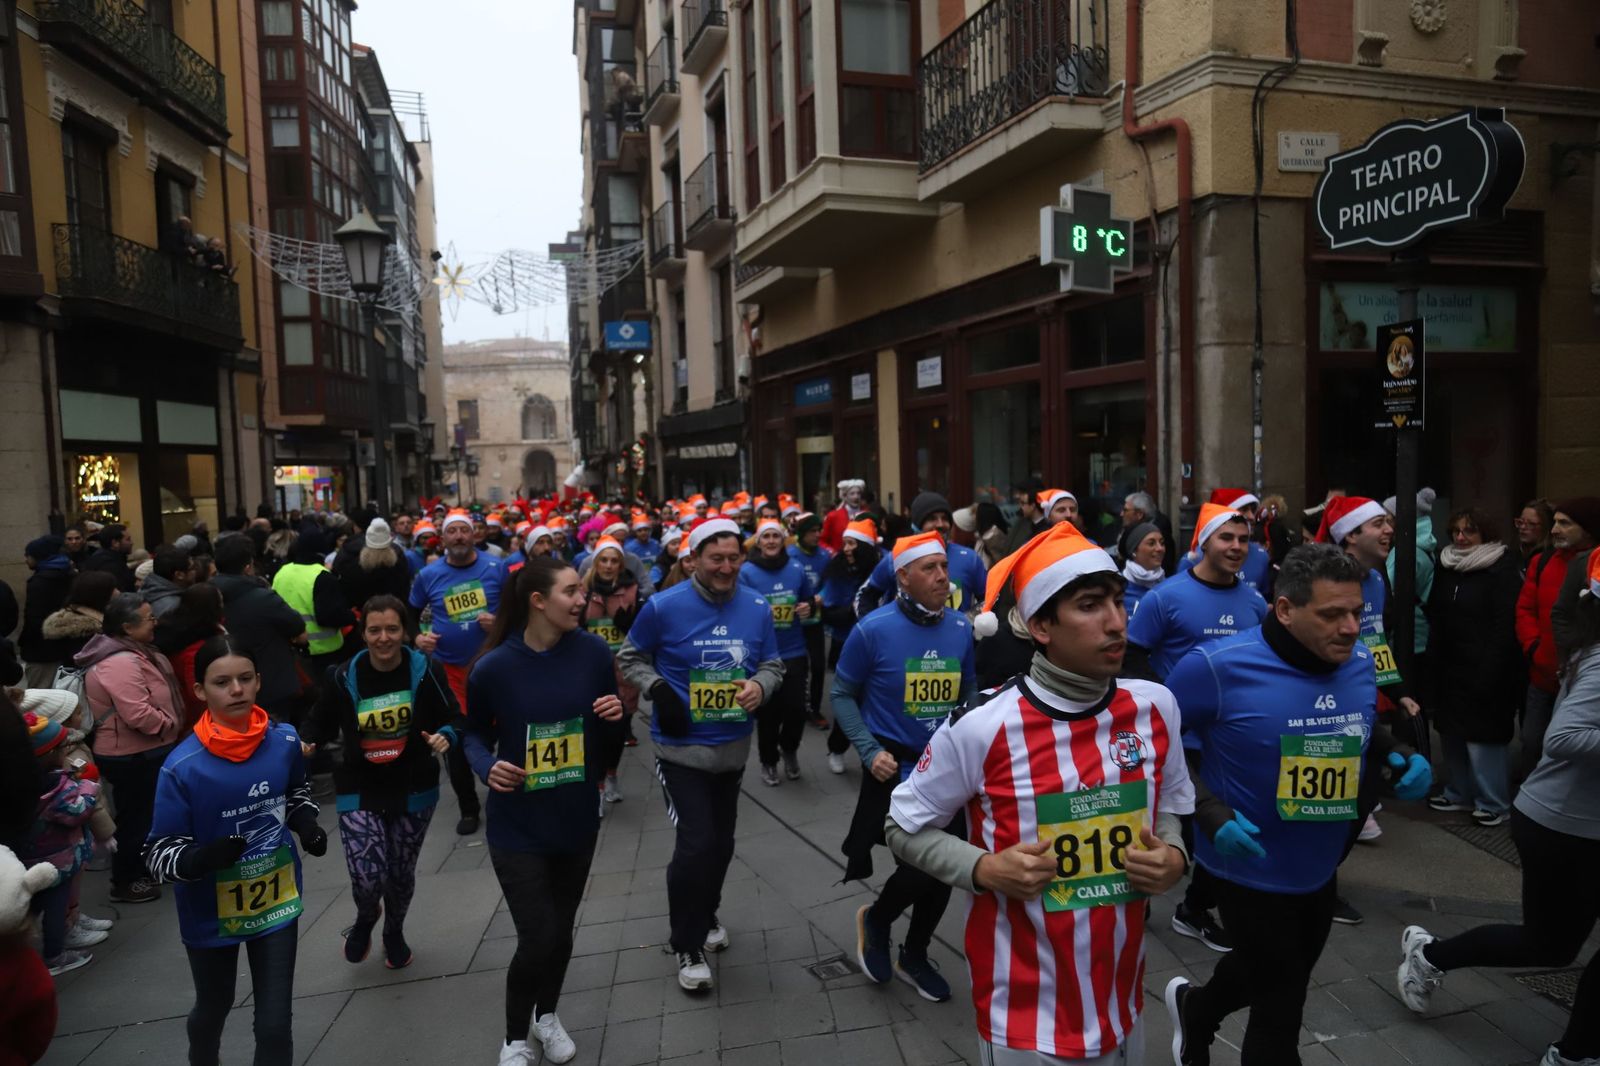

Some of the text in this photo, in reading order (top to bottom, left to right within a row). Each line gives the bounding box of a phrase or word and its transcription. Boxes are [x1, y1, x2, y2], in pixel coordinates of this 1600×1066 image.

[1300, 138, 1325, 146] CALLE
[1351, 144, 1442, 191] TEATRO
[1339, 179, 1461, 230] PRINCIPAL
[1073, 225, 1087, 252] 8
[449, 591, 479, 611] 1188
[711, 625, 728, 636] 46
[1219, 615, 1235, 626] 46
[923, 650, 938, 660] 46
[694, 688, 737, 710] 1267
[910, 678, 952, 702] 1308
[1314, 694, 1337, 710] 46
[364, 706, 412, 731] 459
[1288, 719, 1304, 727] SAN
[1306, 713, 1346, 726] SILVESTRE
[528, 738, 569, 769] 141
[248, 781, 270, 797] 46
[1287, 765, 1347, 800] 1301
[222, 809, 237, 818] SAN
[238, 798, 275, 814] SILVESTRE
[1070, 799, 1121, 814] CAJA RURAL
[1301, 804, 1354, 814] CAJA RURAL
[1054, 825, 1133, 878] 818
[241, 867, 257, 876] CAJA
[258, 861, 277, 872] RURAL
[228, 873, 280, 912] 121
[1076, 885, 1111, 899] CAJA
[244, 904, 299, 929] CAJA RURAL
